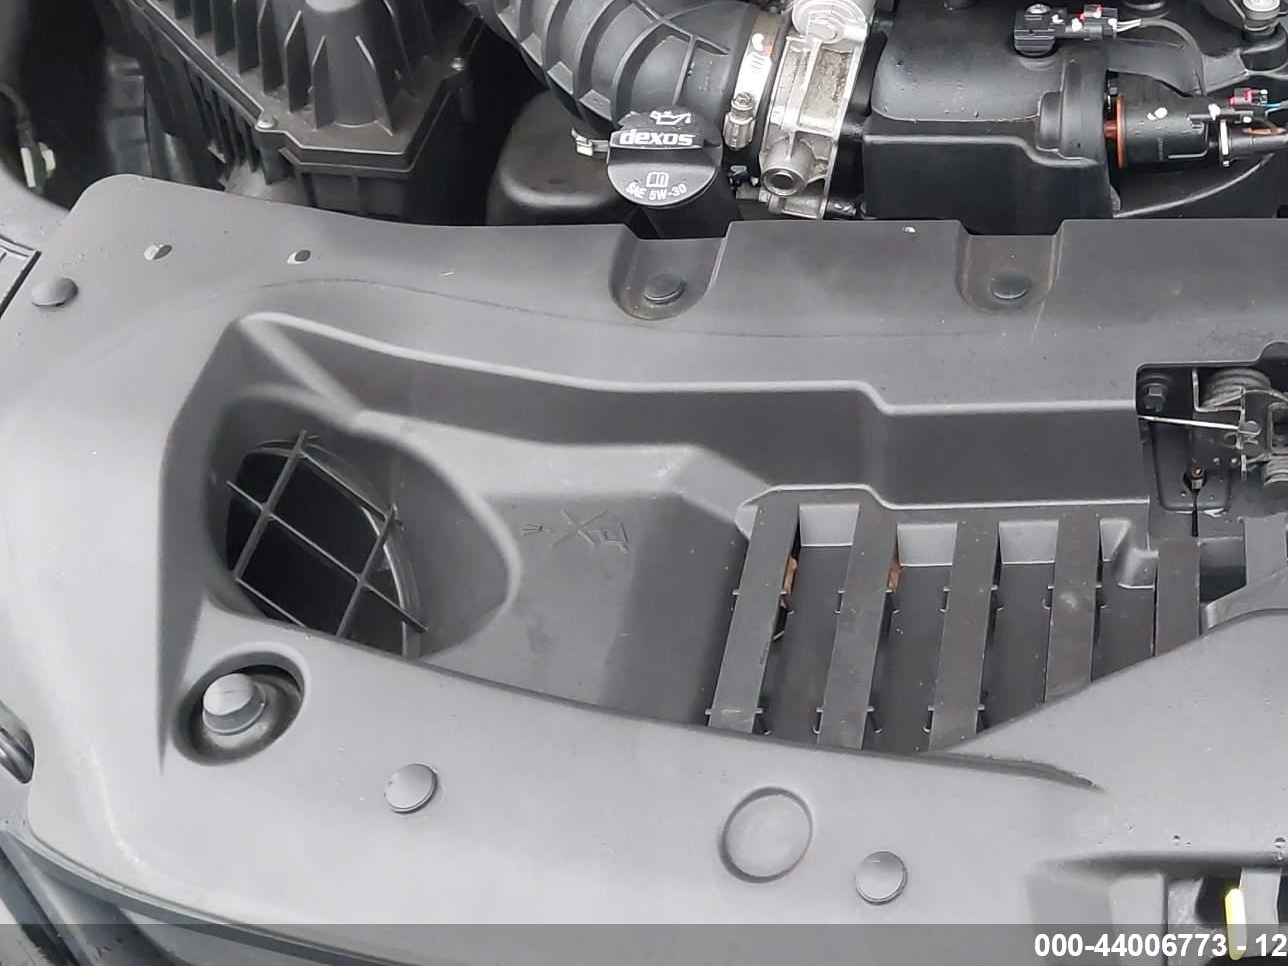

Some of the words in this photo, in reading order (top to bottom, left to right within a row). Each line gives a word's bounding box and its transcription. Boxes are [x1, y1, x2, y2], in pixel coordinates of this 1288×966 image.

[619, 128, 697, 146] dexos
[625, 181, 647, 199] SAE
[648, 182, 687, 201] 5W-30
